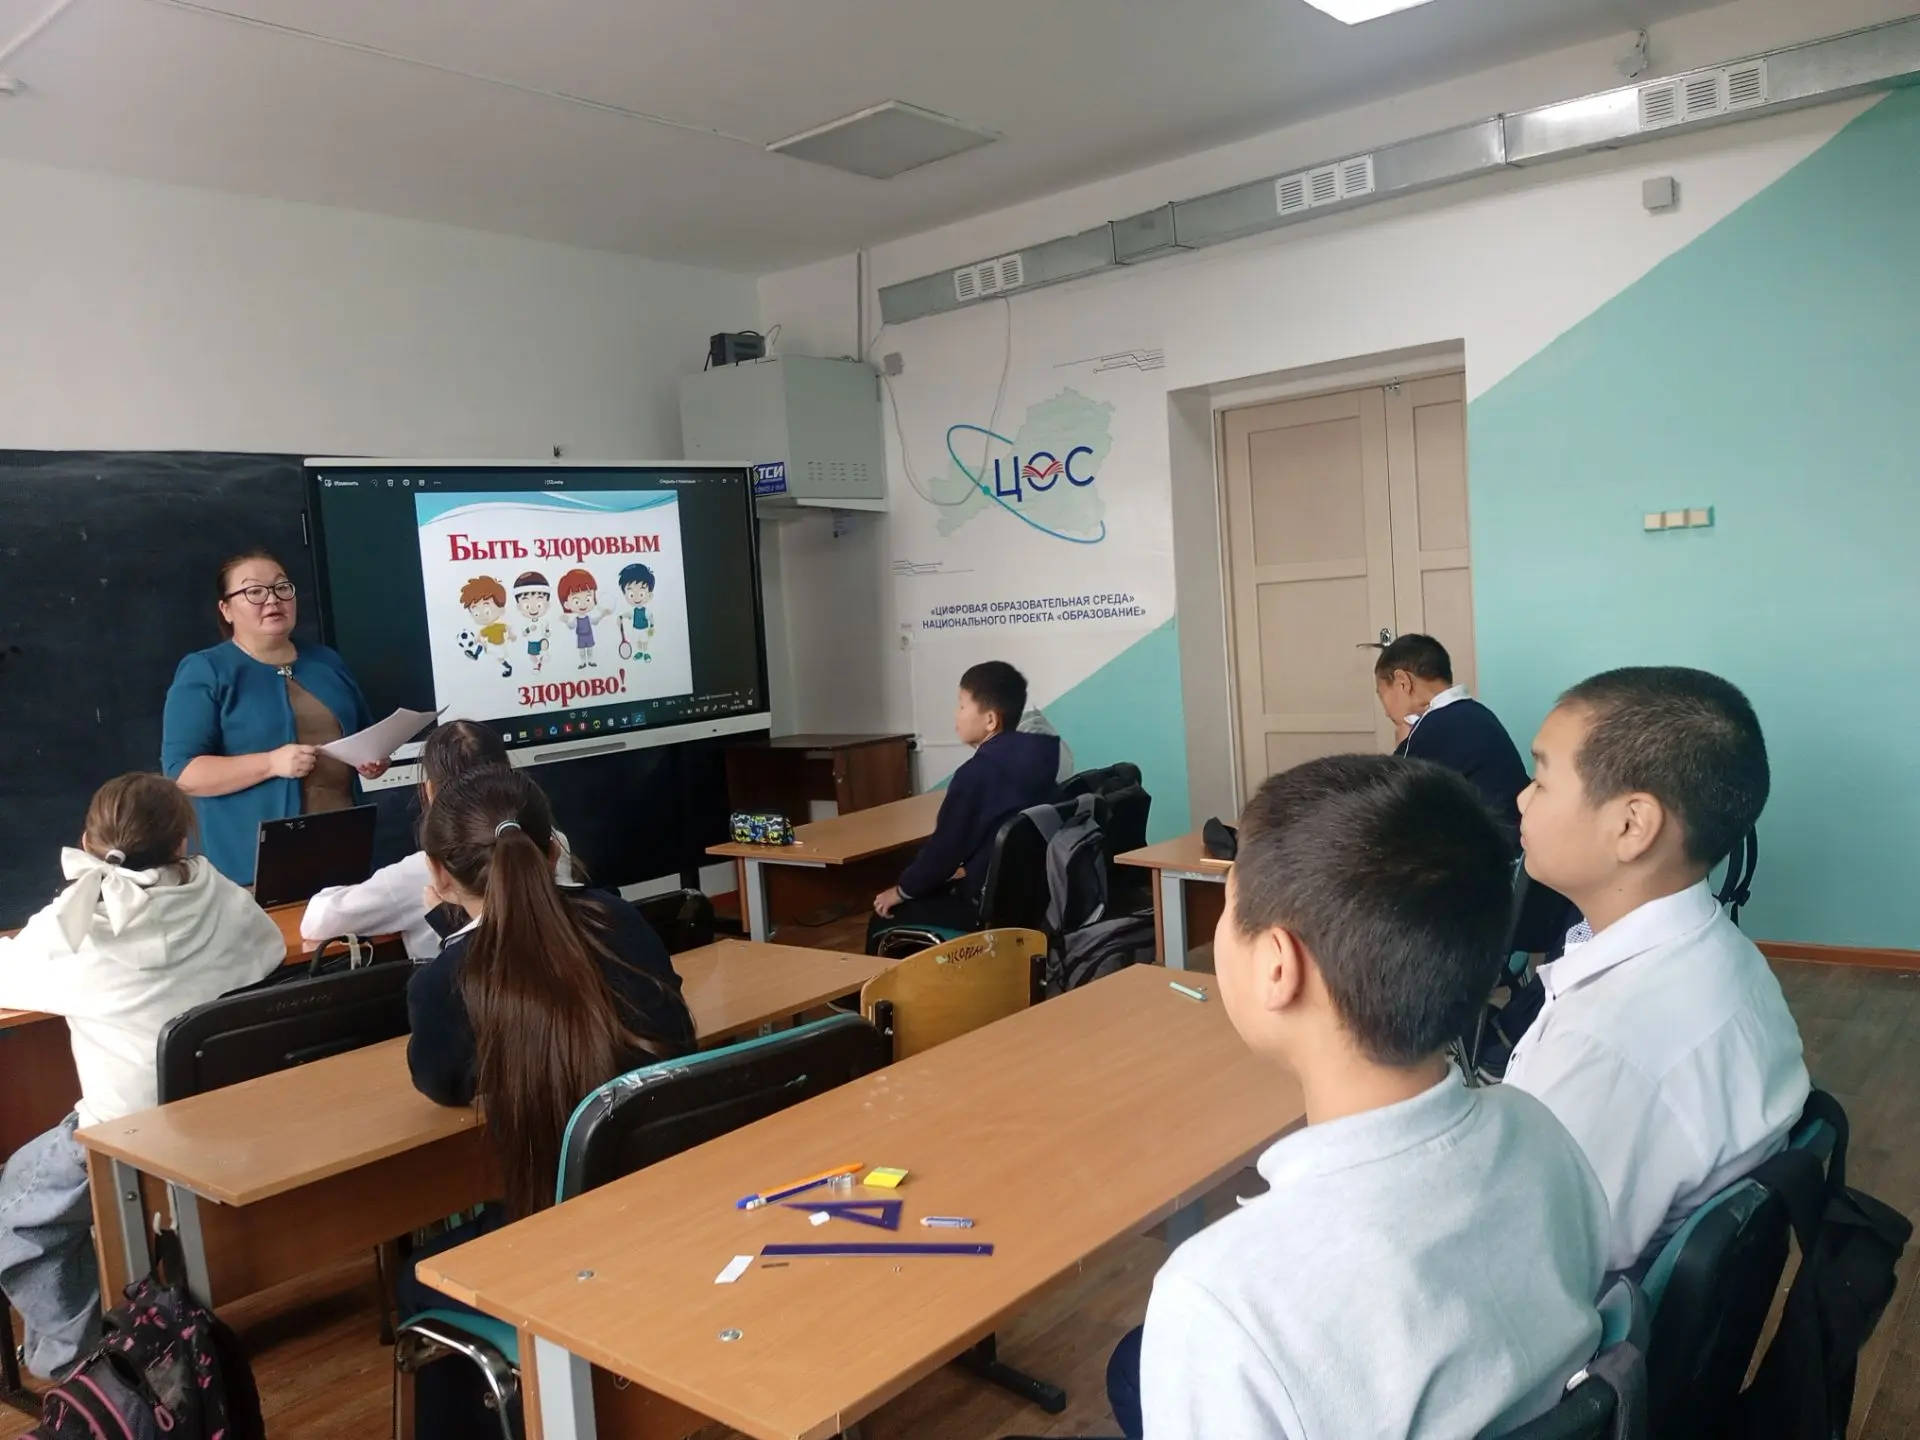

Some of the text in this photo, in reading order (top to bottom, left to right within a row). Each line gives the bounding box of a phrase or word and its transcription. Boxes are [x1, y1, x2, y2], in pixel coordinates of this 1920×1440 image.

[758, 465, 784, 480] ТСИ
[994, 446, 1095, 503] ЦОС
[447, 533, 661, 563] Быть здоровым
[922, 614, 1007, 630] НАЦИОНАЛЬНОГО
[1008, 611, 1055, 625] ПРОЕКТА
[1056, 606, 1147, 621] «ОБРАЗОВАНИЕ»
[930, 592, 1136, 617] «ЦИФРОВАЯ ОБРАЗОВАТЕЛЬНАЯ СРЕДА»
[517, 668, 627, 709] здорово!
